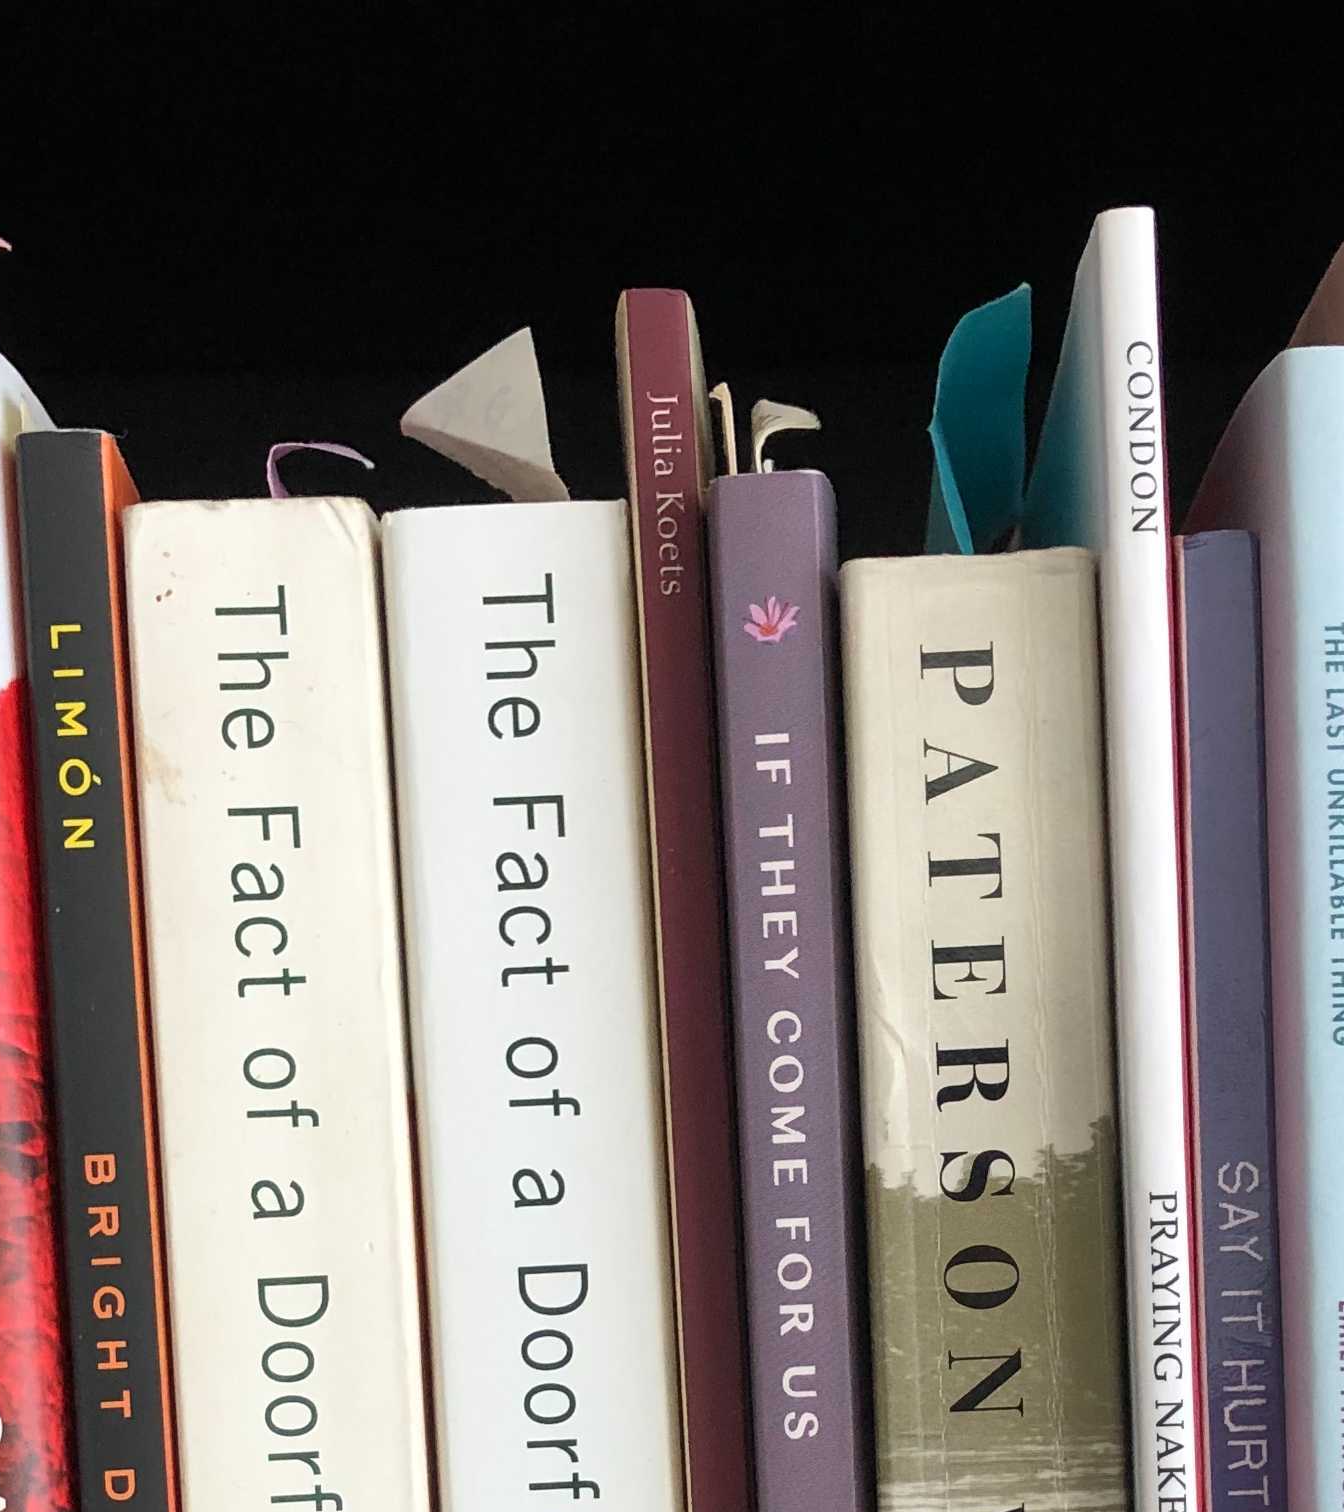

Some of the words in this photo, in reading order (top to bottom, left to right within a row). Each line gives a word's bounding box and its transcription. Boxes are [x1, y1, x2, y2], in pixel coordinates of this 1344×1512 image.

[647, 392, 684, 480] Julia
[654, 491, 685, 597] Koets
[215, 584, 289, 751] The
[482, 572, 556, 739] The
[754, 731, 792, 786] IF
[227, 805, 307, 999] Fact
[492, 794, 570, 988] Fact
[758, 812, 800, 979] THEY
[1125, 340, 1160, 536] CONDON
[1148, 1190, 1182, 1384] PRAYING
[50, 623, 104, 849] LIMÓN
[84, 1153, 132, 1420] BRIGHT
[504, 1034, 581, 1118] of
[919, 639, 1025, 1419] PATERSON
[242, 1048, 320, 1129] of
[765, 1009, 808, 1188] COME
[250, 1177, 305, 1220] a
[512, 1167, 565, 1209] a
[1216, 1160, 1264, 1262] SAY
[773, 1215, 815, 1337] FOR
[1220, 1288, 1265, 1342] IT
[781, 1364, 819, 1441] US
